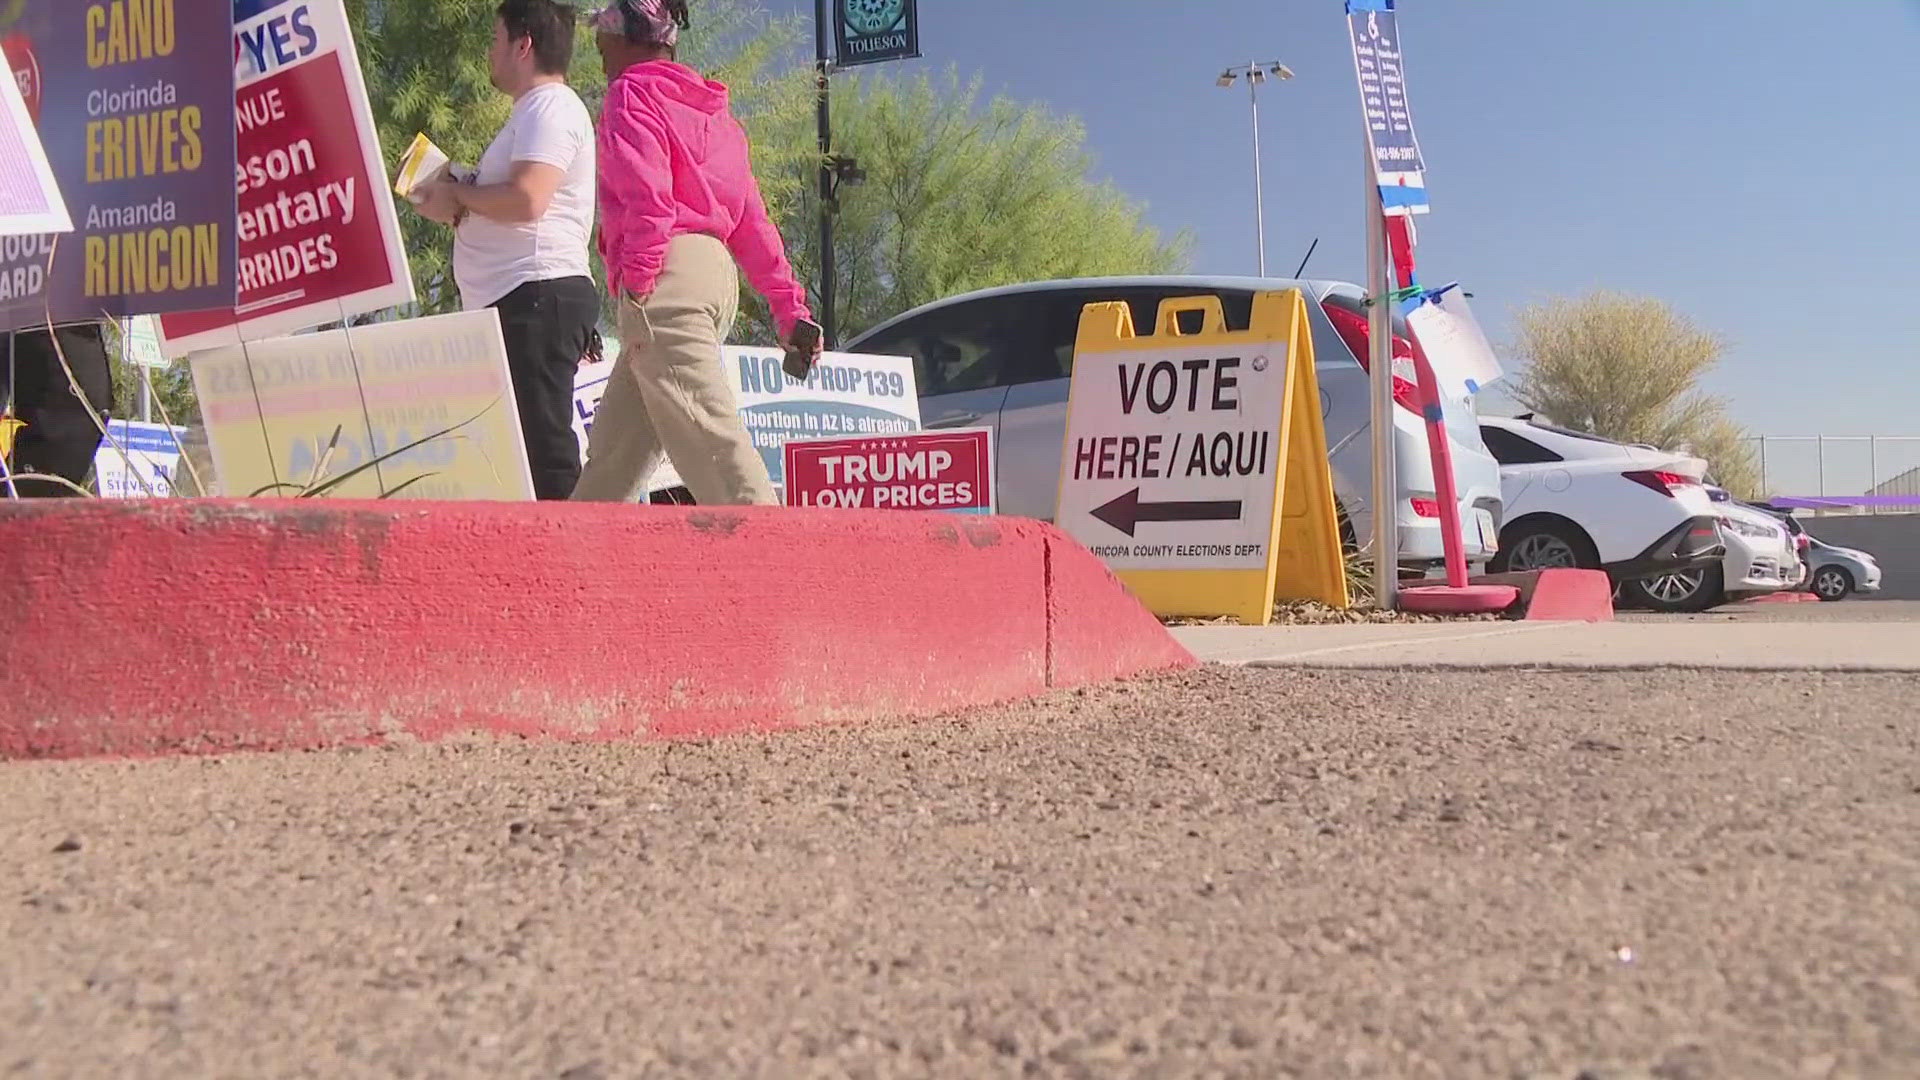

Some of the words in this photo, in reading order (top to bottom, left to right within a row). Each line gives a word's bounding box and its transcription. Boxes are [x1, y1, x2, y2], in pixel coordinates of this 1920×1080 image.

[240, 5, 318, 74] YES
[847, 34, 906, 55] TOLLESON
[86, 79, 177, 117] Clorinda
[86, 105, 202, 183] ERIVES
[85, 195, 176, 230] Amanda
[238, 176, 355, 242] entary
[0, 233, 53, 264] OOL
[84, 223, 219, 297] RINCON
[739, 355, 783, 394] NO
[808, 365, 862, 393] PROP
[863, 370, 904, 397] 139
[1118, 357, 1241, 415] VOTE
[740, 409, 800, 429] Abortion
[822, 413, 839, 431] AZ
[858, 415, 909, 433] already
[818, 450, 952, 484] TRUMP
[801, 486, 865, 508] LOW
[873, 481, 973, 508] PRICES
[1087, 545, 1130, 557] ARICOPA
[1133, 545, 1174, 557] COUNTY
[1176, 545, 1232, 557] ELECTIONS
[1234, 544, 1264, 557] DEPT.
